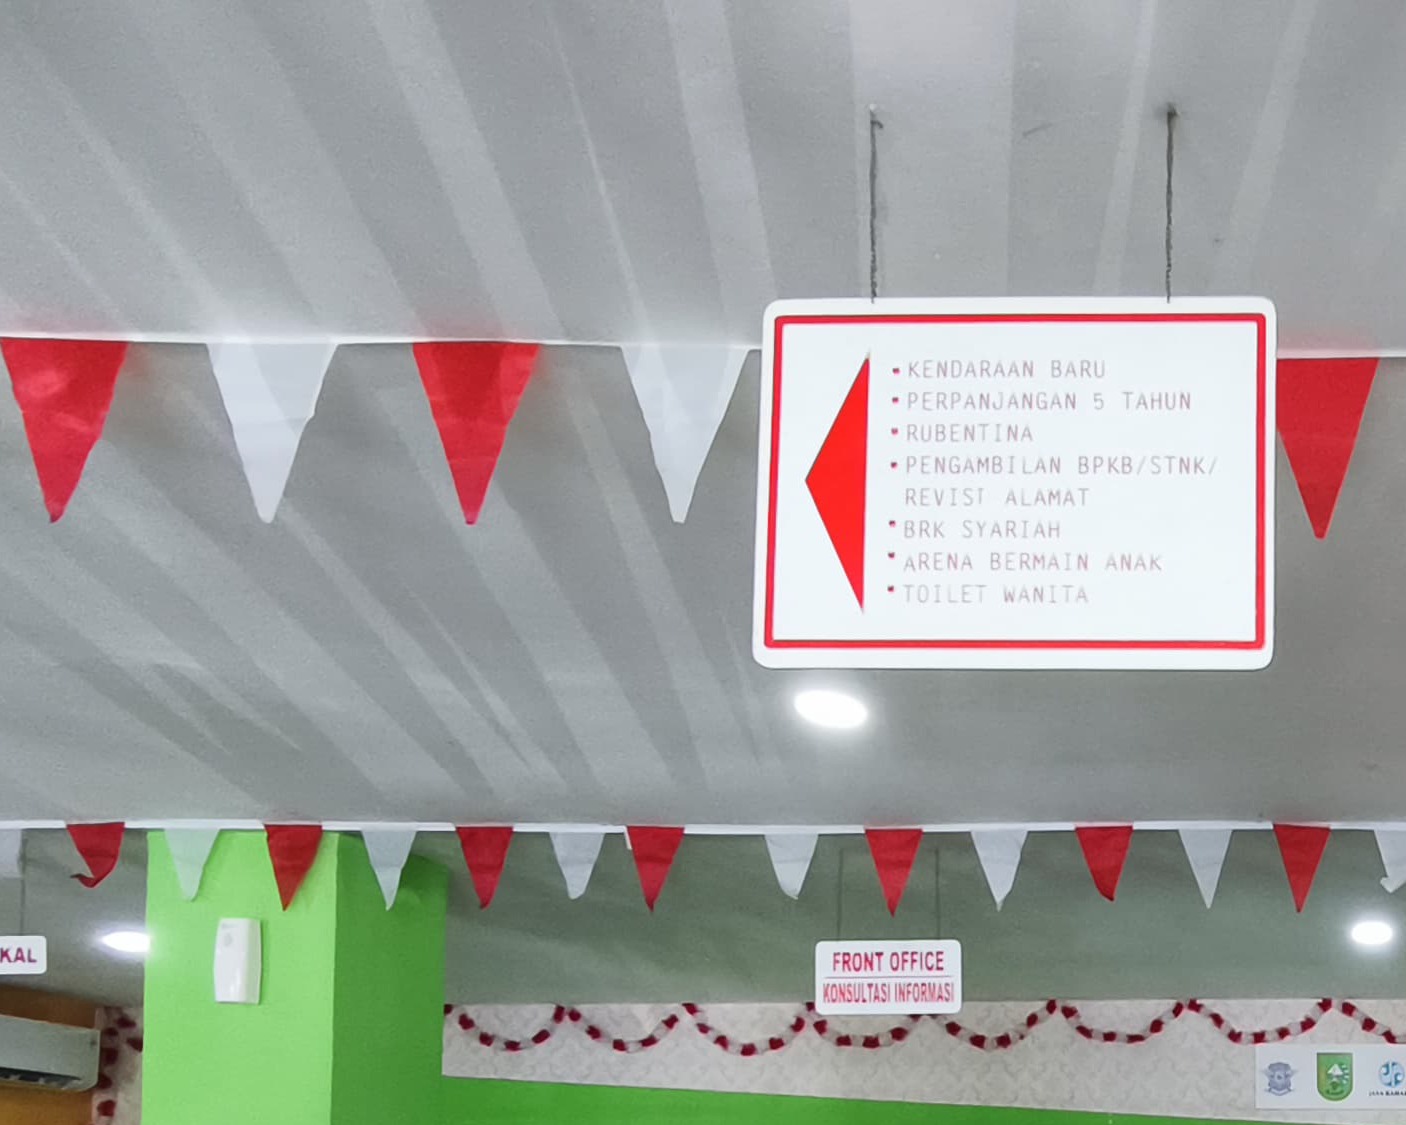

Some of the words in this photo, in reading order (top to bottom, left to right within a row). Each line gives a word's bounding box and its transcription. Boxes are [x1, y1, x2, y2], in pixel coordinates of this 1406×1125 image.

[909, 360, 1033, 378] KENDARAAN
[1051, 360, 1104, 378] BARU
[908, 392, 1076, 411] PERPANJANGAN
[1094, 393, 1104, 410] 5
[1122, 392, 1190, 410] TAHUN
[907, 424, 1032, 442] RUBENTINA
[907, 456, 1060, 474] PENGAMBILAN
[1078, 456, 1216, 474] BPKB/STNK/
[1006, 488, 1088, 506] ALAMAT
[904, 520, 944, 538] BRK
[963, 520, 1060, 538] SYARIAH
[904, 552, 972, 571] ARENA
[990, 552, 1088, 570] BERMAIN
[1105, 554, 1161, 570] ANAK
[903, 585, 986, 603] TOILET
[1004, 585, 1087, 603] WANITA
[833, 952, 884, 971] FRONT
[889, 951, 944, 971] OFFICE
[823, 983, 890, 1003] KONSULTASI
[894, 983, 954, 1003] INFORMASI
